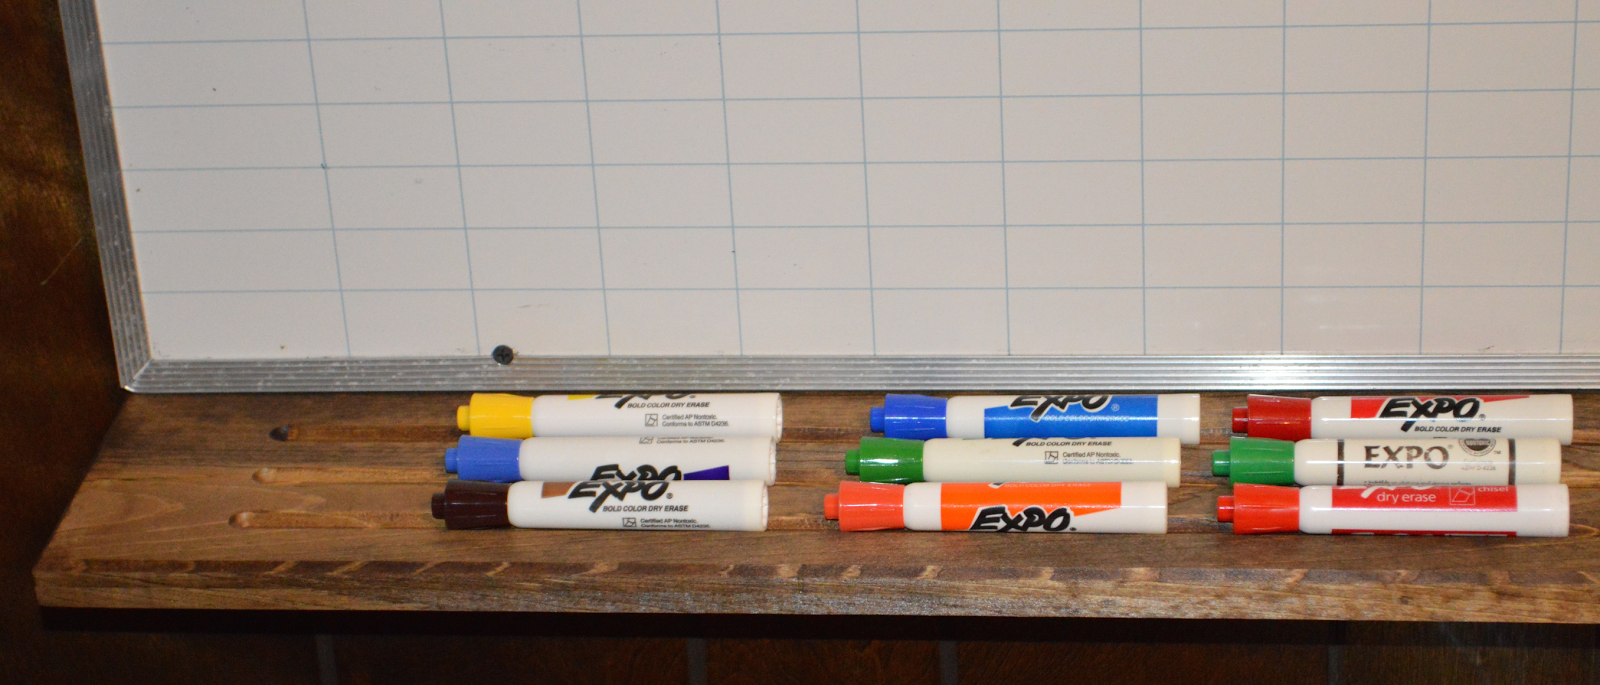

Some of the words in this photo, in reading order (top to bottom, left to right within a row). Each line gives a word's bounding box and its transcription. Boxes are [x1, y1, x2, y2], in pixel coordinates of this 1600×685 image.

[1379, 397, 1481, 432] EXPO
[1363, 445, 1449, 469] EXPO
[567, 481, 670, 513] EXPO
[1376, 492, 1399, 504] dry
[1401, 493, 1437, 502] erase
[968, 506, 1071, 532] EXPO
